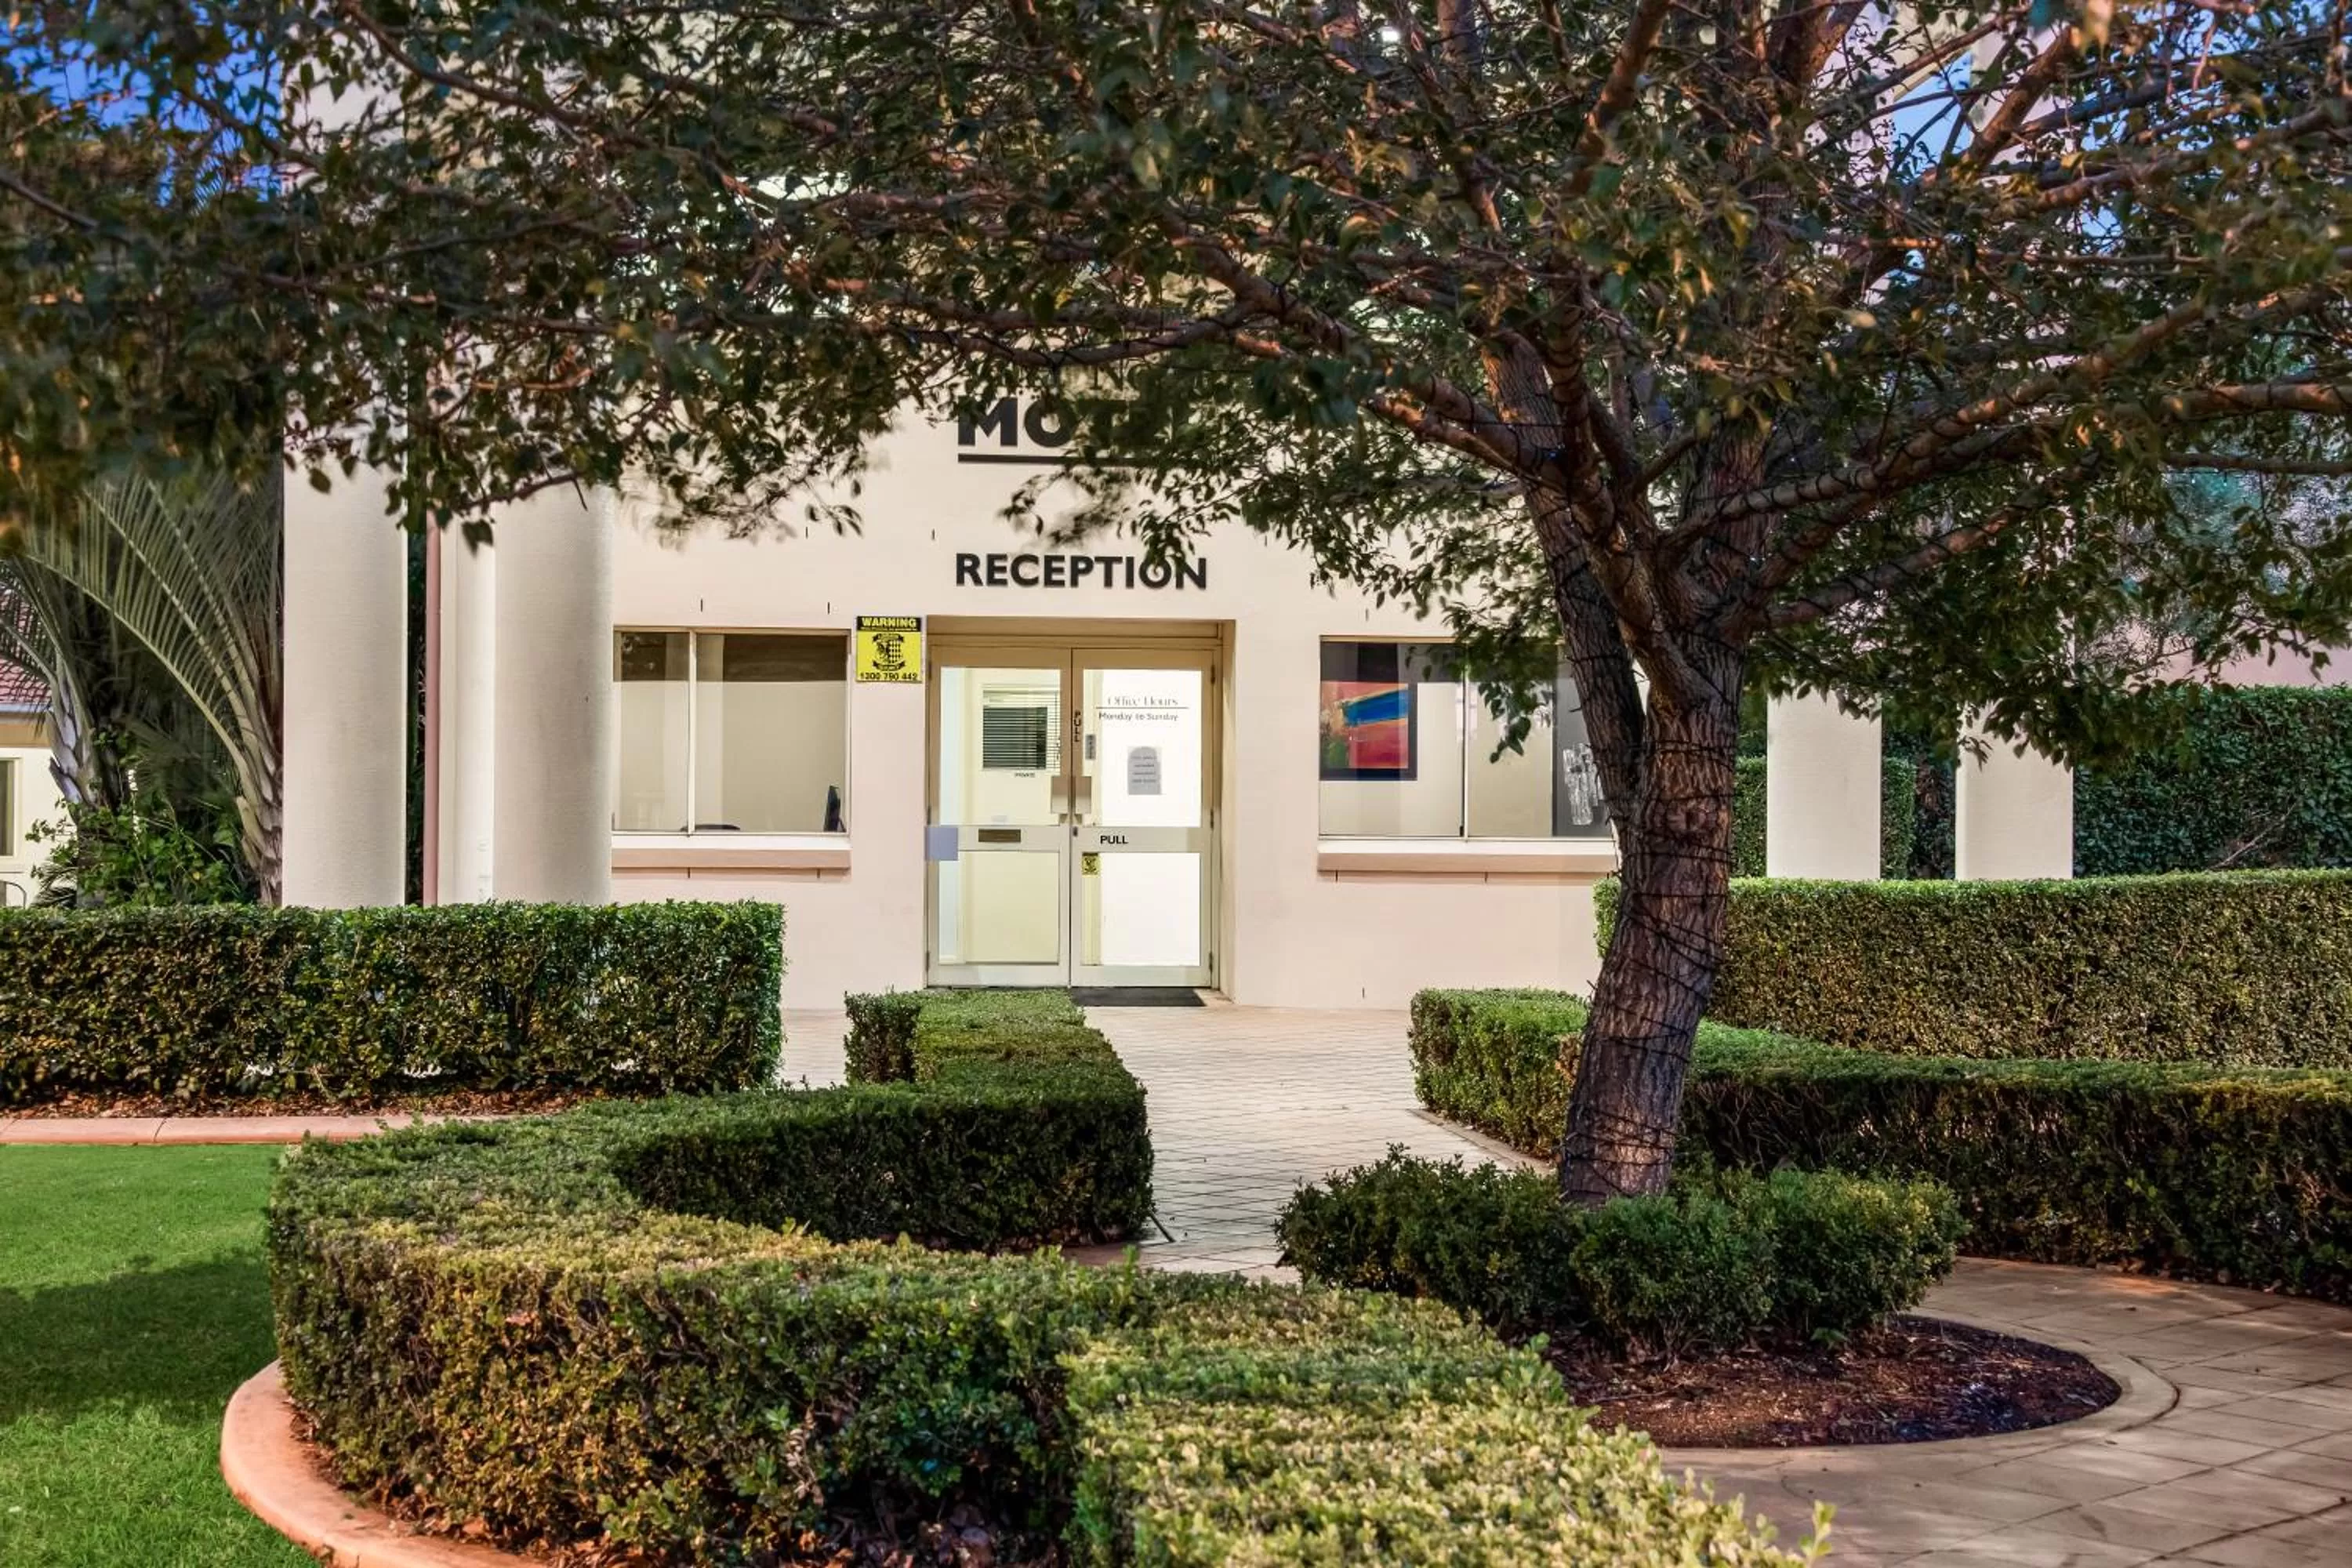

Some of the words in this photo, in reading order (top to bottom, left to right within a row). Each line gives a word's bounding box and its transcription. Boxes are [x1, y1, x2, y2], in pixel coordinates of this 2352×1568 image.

[956, 553, 1207, 590] RECEPTION
[862, 617, 916, 628] WARNING
[1098, 712, 1132, 721] Monday
[1147, 712, 1178, 721] Sunday
[1099, 835, 1129, 844] PULL
